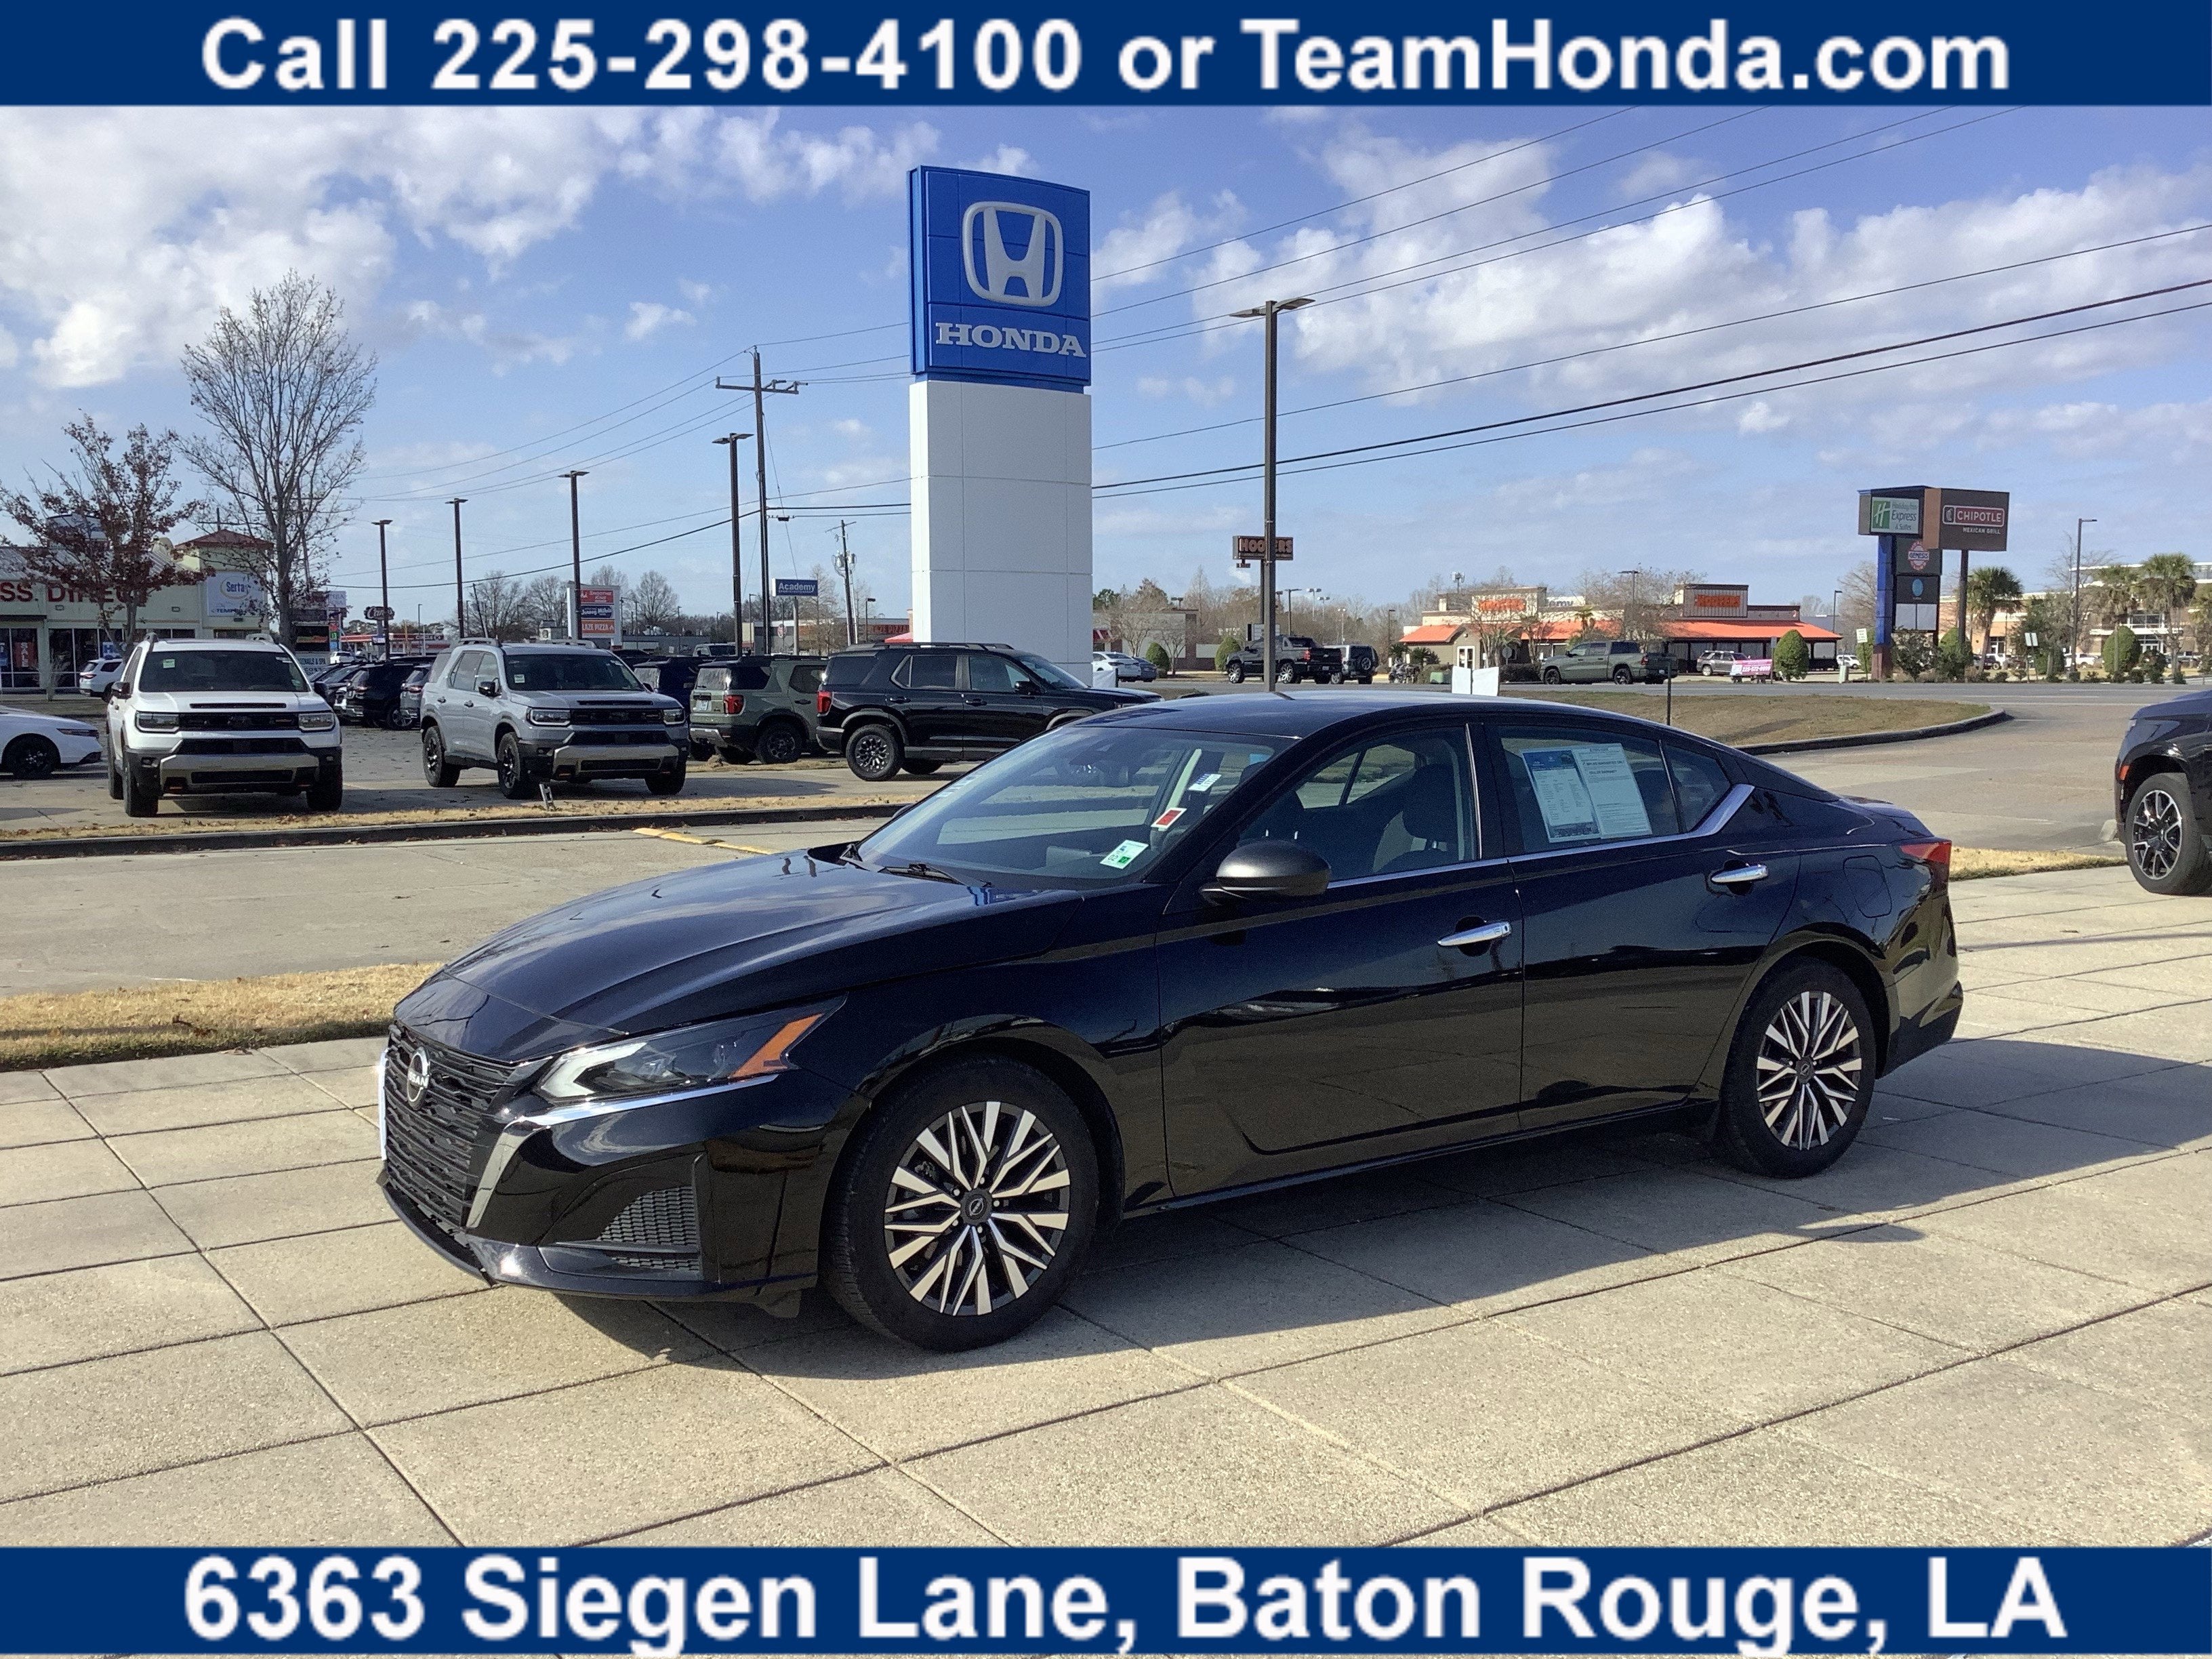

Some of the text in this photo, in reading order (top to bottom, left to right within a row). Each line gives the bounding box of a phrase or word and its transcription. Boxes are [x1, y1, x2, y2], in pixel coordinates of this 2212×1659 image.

[936, 322, 1086, 358] HONDA
[1891, 510, 1917, 522] Express
[1957, 510, 2002, 523] CHIPOTLE
[226, 581, 245, 592] Serta
[778, 582, 815, 592] Academy
[20, 642, 29, 668] SALE
